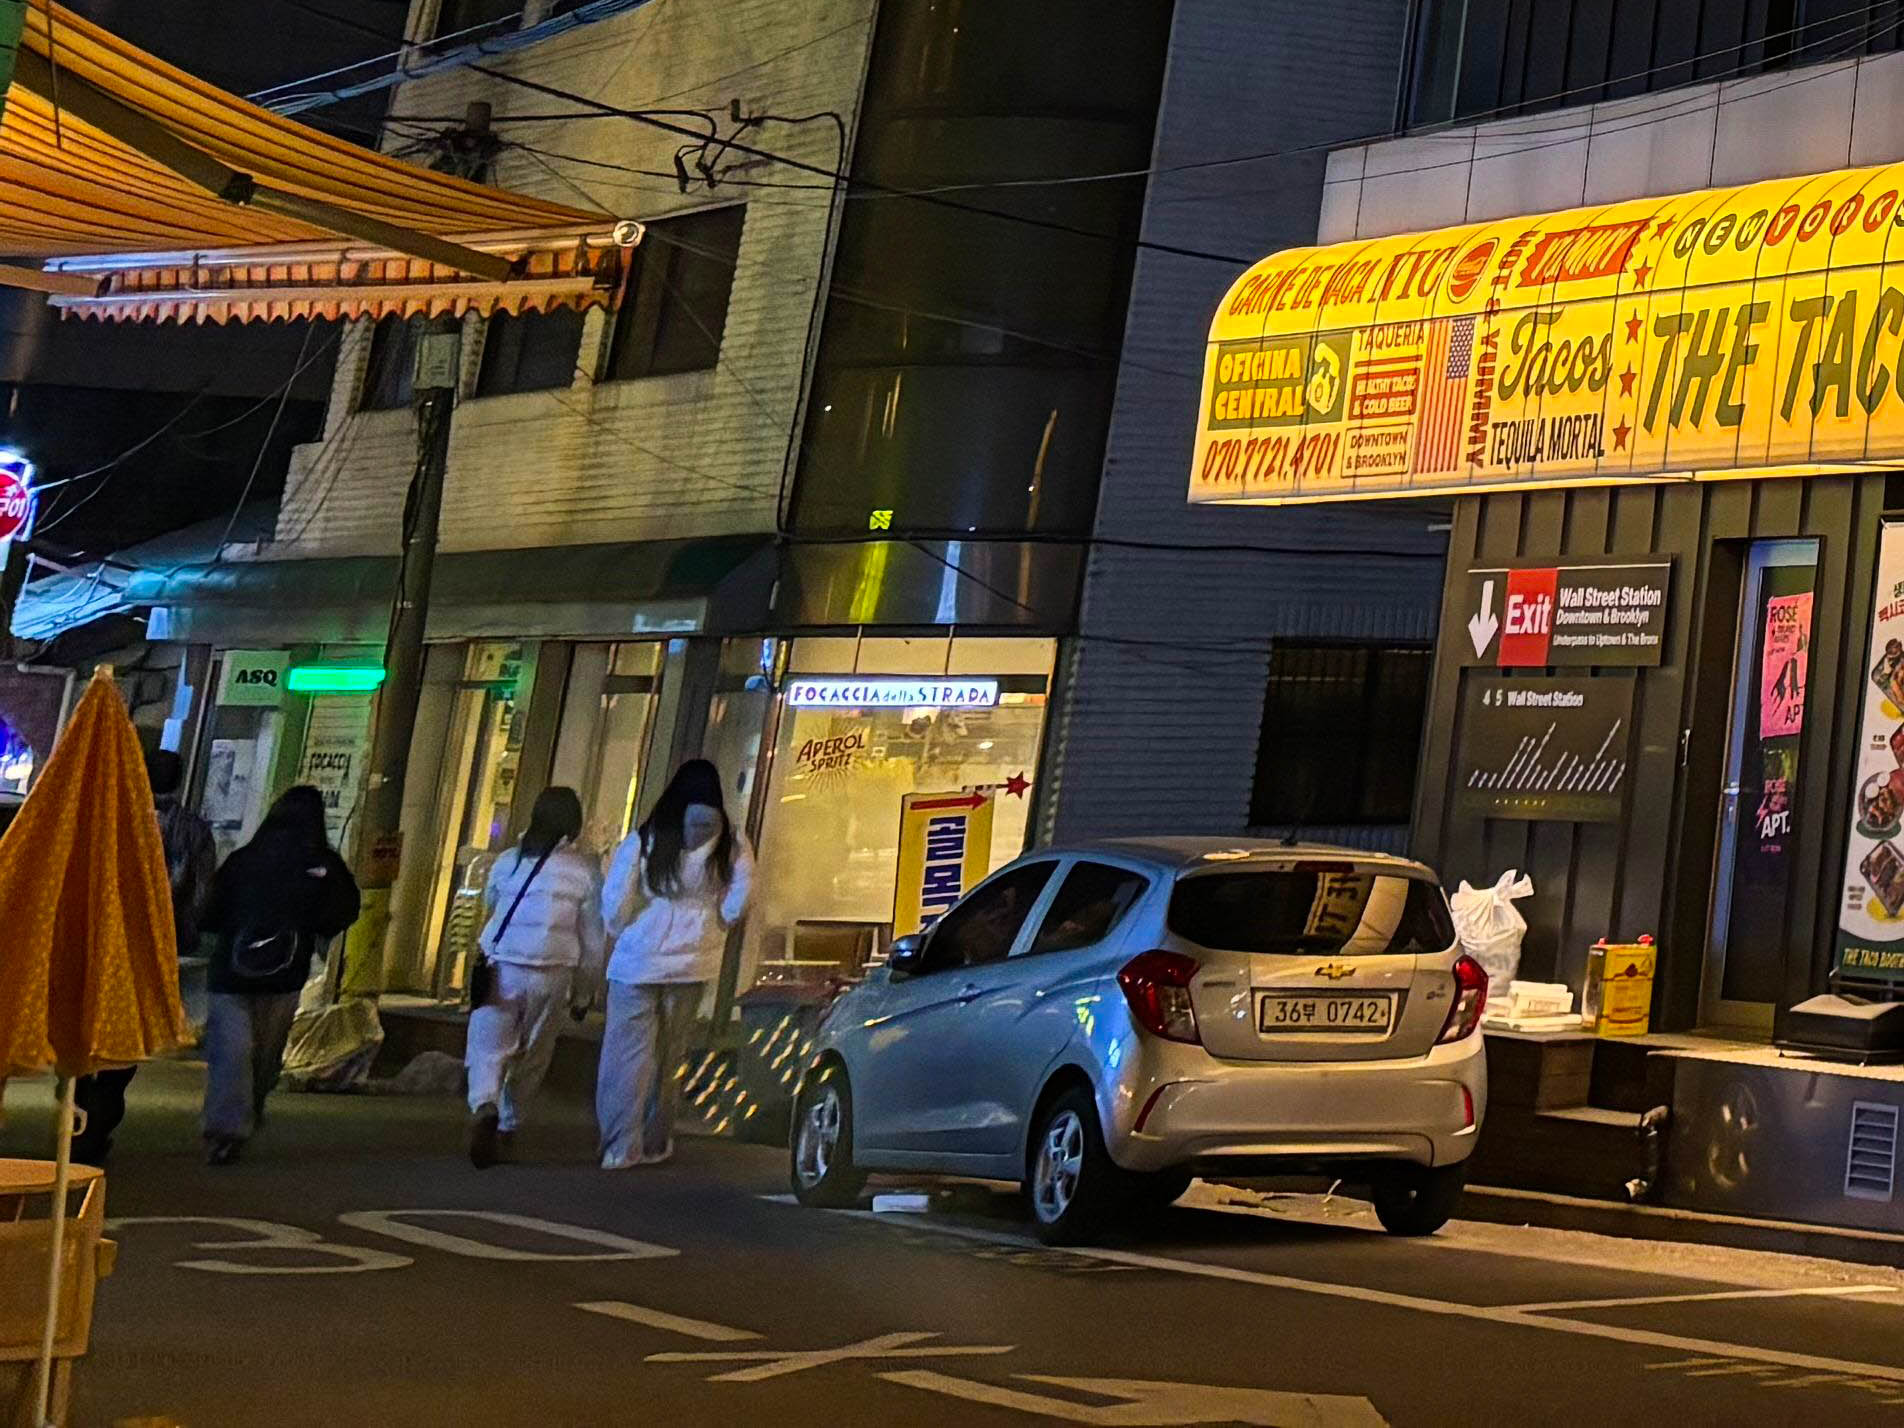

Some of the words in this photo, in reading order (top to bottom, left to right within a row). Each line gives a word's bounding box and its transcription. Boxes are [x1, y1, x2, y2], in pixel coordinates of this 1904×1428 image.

[1764, 190, 1898, 245] YORK
[1367, 246, 1459, 304] NYC
[1358, 322, 1425, 353] TAQUERIA
[1498, 306, 1614, 401] Tacos
[1218, 348, 1301, 384] OFICINA
[1642, 299, 1769, 435] THE
[1214, 385, 1305, 421] CENTRAL
[1466, 328, 1501, 469] YUMMY
[1491, 416, 1544, 469] TEQUILA
[1549, 413, 1605, 461] MORTAL
[1505, 593, 1551, 635] Exit
[1560, 587, 1584, 607] Wall
[1585, 587, 1621, 607] Street
[1621, 585, 1662, 607] Station
[1610, 608, 1649, 627] Brooklyn
[793, 686, 880, 702] FOCACCIA
[918, 686, 989, 702] STRADA
[1495, 689, 1503, 706] 5
[796, 733, 865, 764] APEROL
[809, 753, 852, 773] SPRITZ
[1761, 810, 1791, 839] APT.
[1327, 1000, 1378, 1023] 0742
